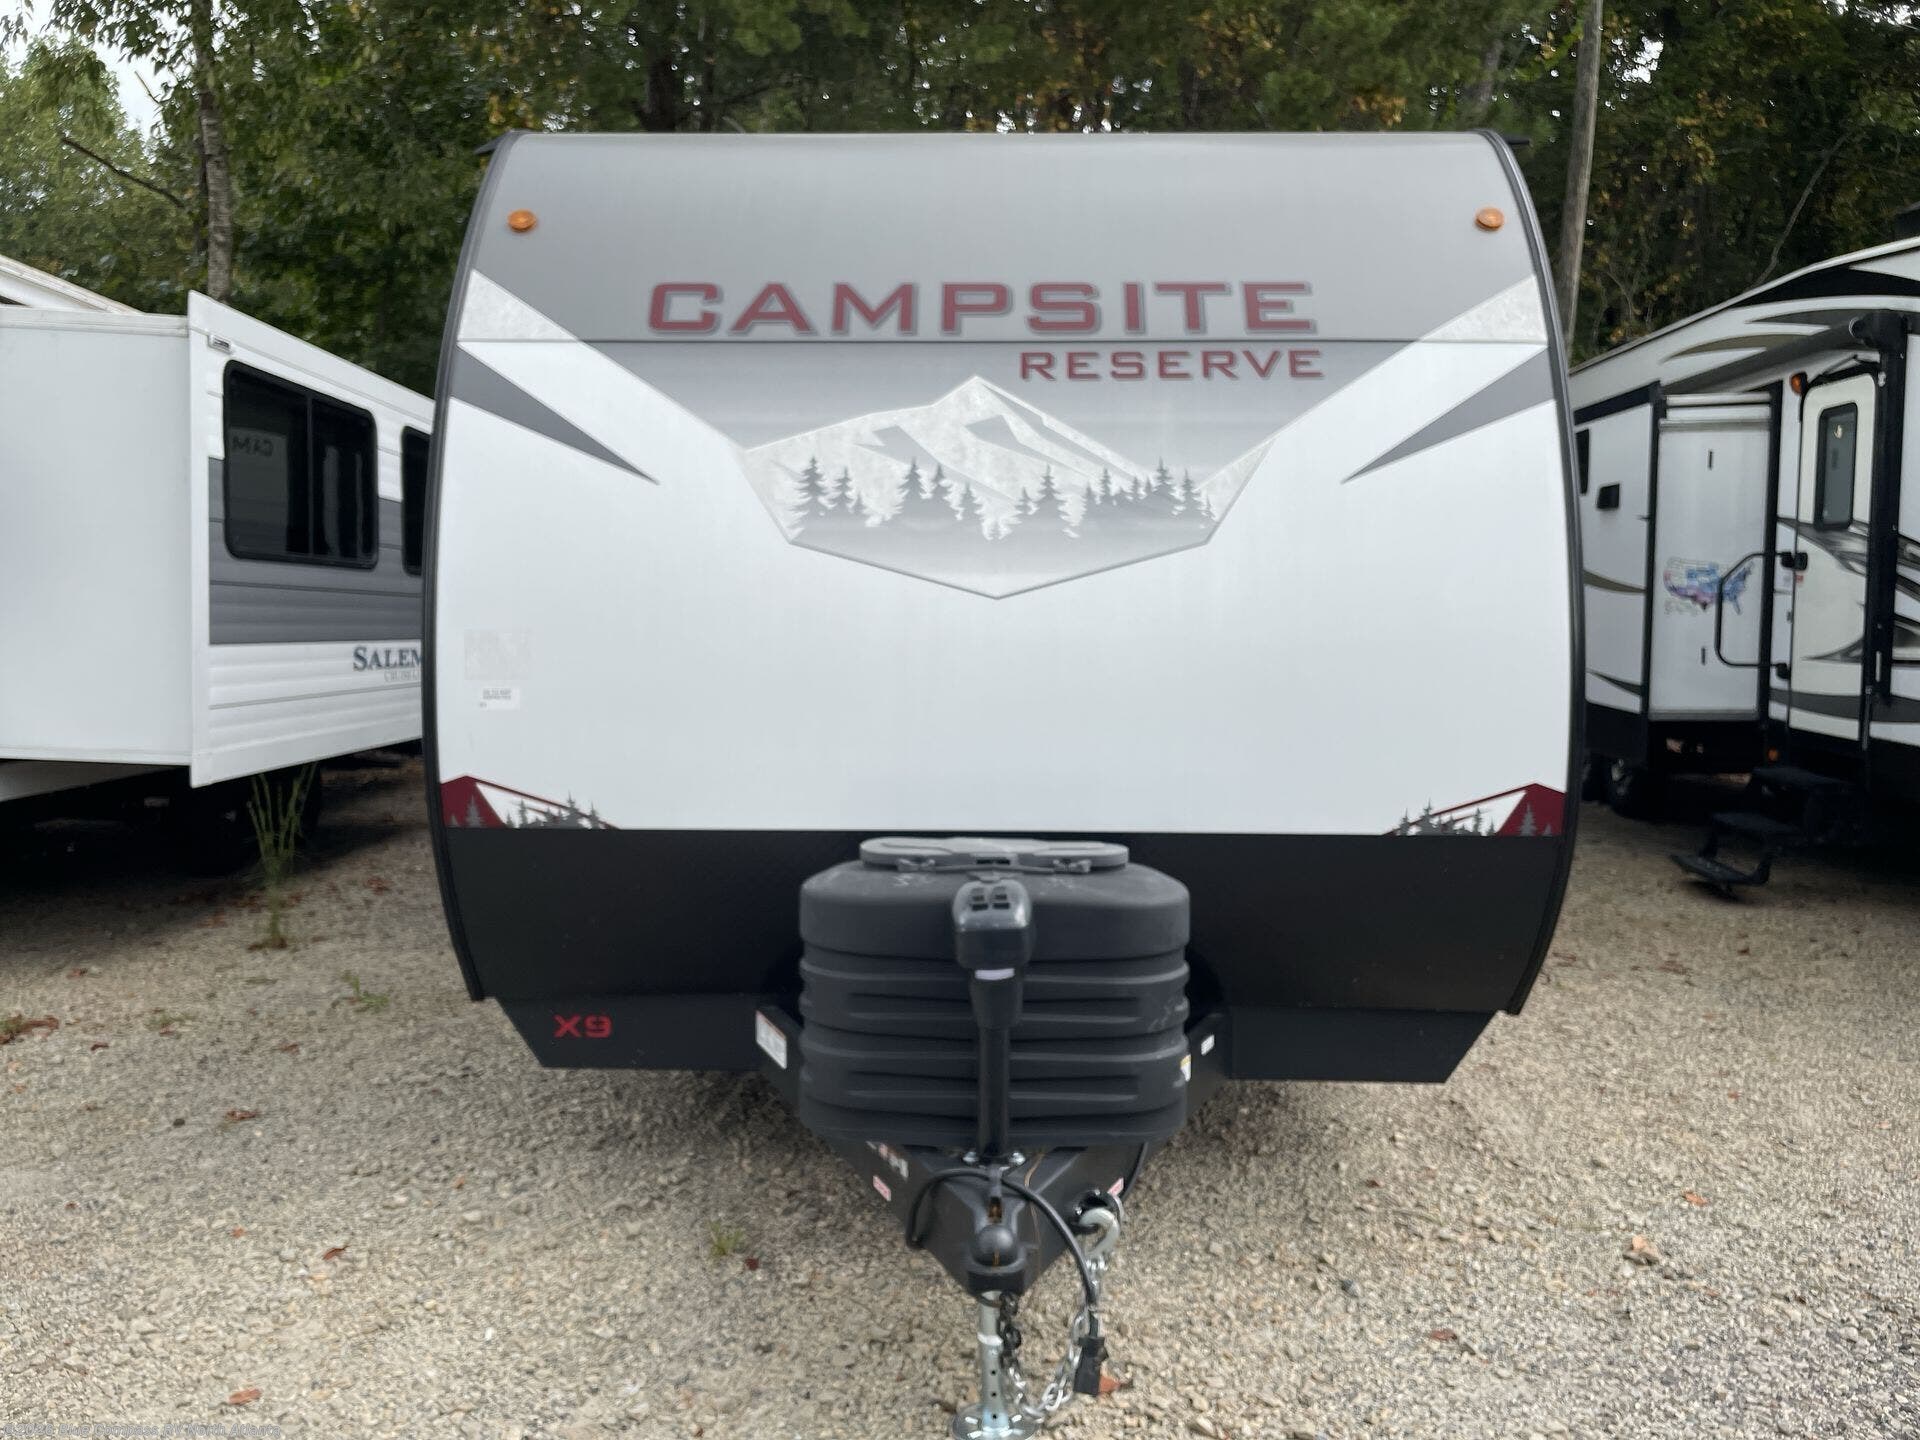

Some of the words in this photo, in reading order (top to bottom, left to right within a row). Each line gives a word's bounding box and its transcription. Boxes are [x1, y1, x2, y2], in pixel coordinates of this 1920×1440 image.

[648, 281, 1318, 336] CAMPSITE
[1019, 349, 1325, 380] RESERVE
[553, 1013, 612, 1038] X9
